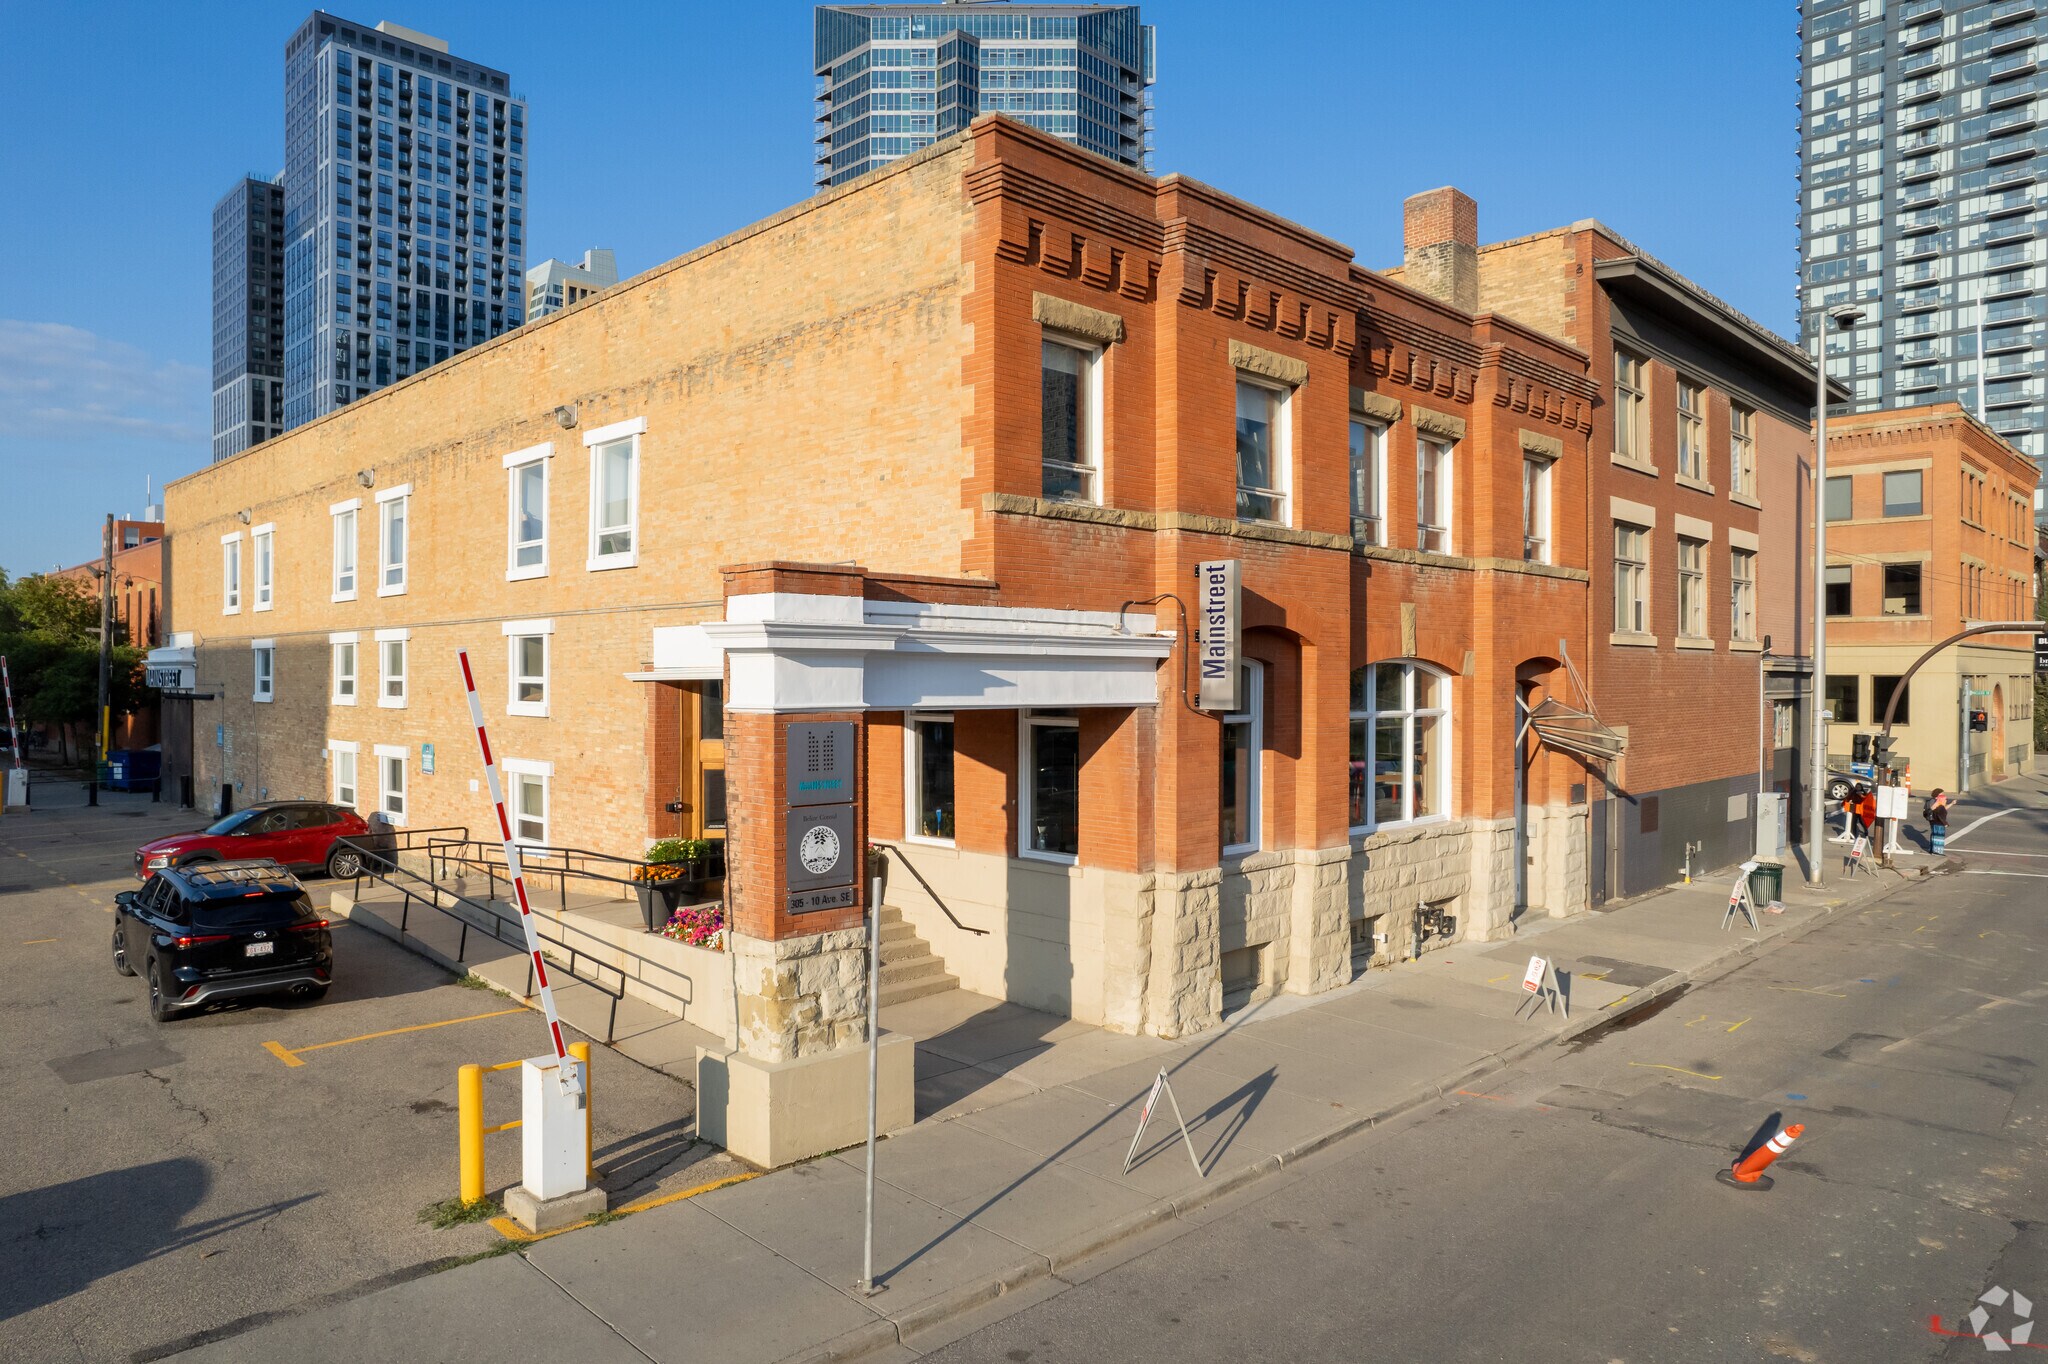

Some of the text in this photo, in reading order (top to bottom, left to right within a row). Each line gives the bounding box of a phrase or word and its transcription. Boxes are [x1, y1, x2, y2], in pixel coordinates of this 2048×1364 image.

[1203, 564, 1226, 679] Mainstreet
[791, 898, 804, 909] 305
[811, 895, 820, 906] 10
[840, 891, 850, 902] SE
